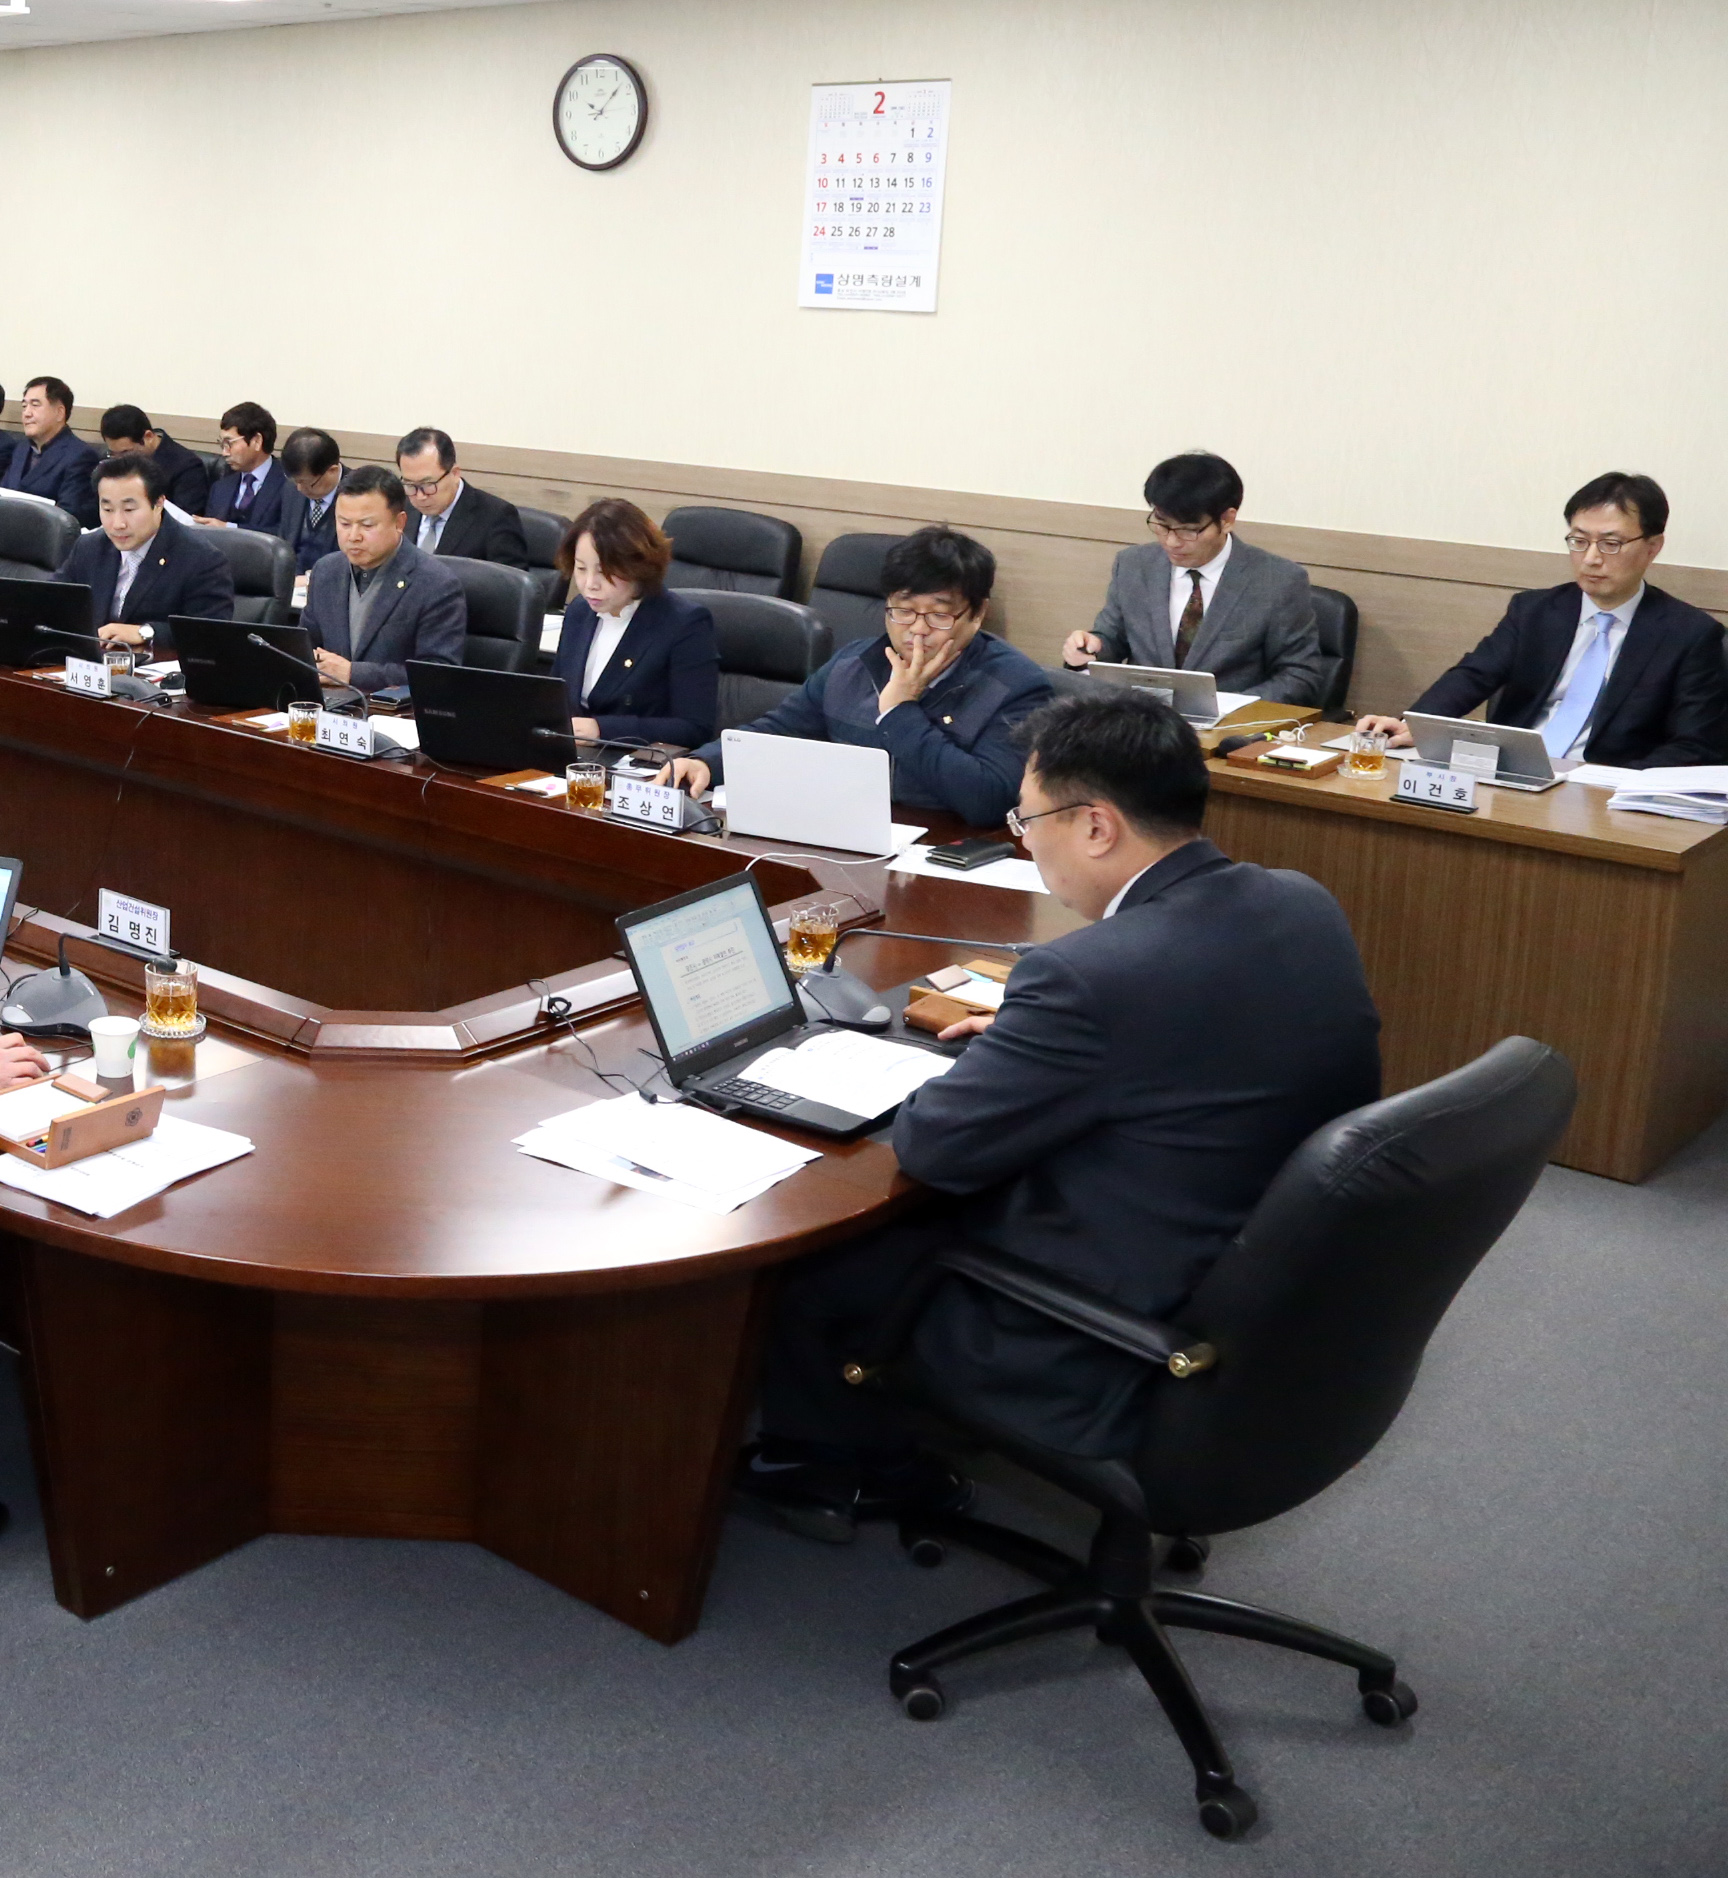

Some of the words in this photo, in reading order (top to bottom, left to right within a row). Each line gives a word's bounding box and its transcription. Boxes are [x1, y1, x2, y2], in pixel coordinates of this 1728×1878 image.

[580, 74, 588, 85] 11
[625, 84, 632, 95] 2
[568, 91, 578, 101] 10
[873, 91, 886, 114] 2
[910, 128, 915, 138] 1
[927, 127, 934, 138] 2
[821, 154, 827, 164] 3
[838, 154, 844, 164] 4
[856, 153, 862, 163] 5
[873, 153, 879, 163] 6
[891, 153, 896, 163] 7
[907, 153, 914, 163] 8
[925, 153, 932, 163] 9
[817, 178, 828, 188] 10
[836, 178, 846, 188] 11
[853, 178, 863, 188] 12
[869, 178, 880, 188] 13
[886, 178, 897, 188] 14
[904, 178, 914, 188] 15
[921, 178, 932, 188] 16
[816, 202, 827, 212] 17
[833, 202, 844, 212] 18
[851, 202, 862, 213] 19
[867, 202, 879, 213] 20
[885, 203, 896, 213] 21
[901, 203, 913, 213] 22
[919, 203, 931, 213] 23
[813, 226, 825, 236] 24
[831, 226, 843, 237] 25
[848, 227, 860, 237] 26
[866, 227, 877, 237] 27
[883, 227, 895, 237] 28
